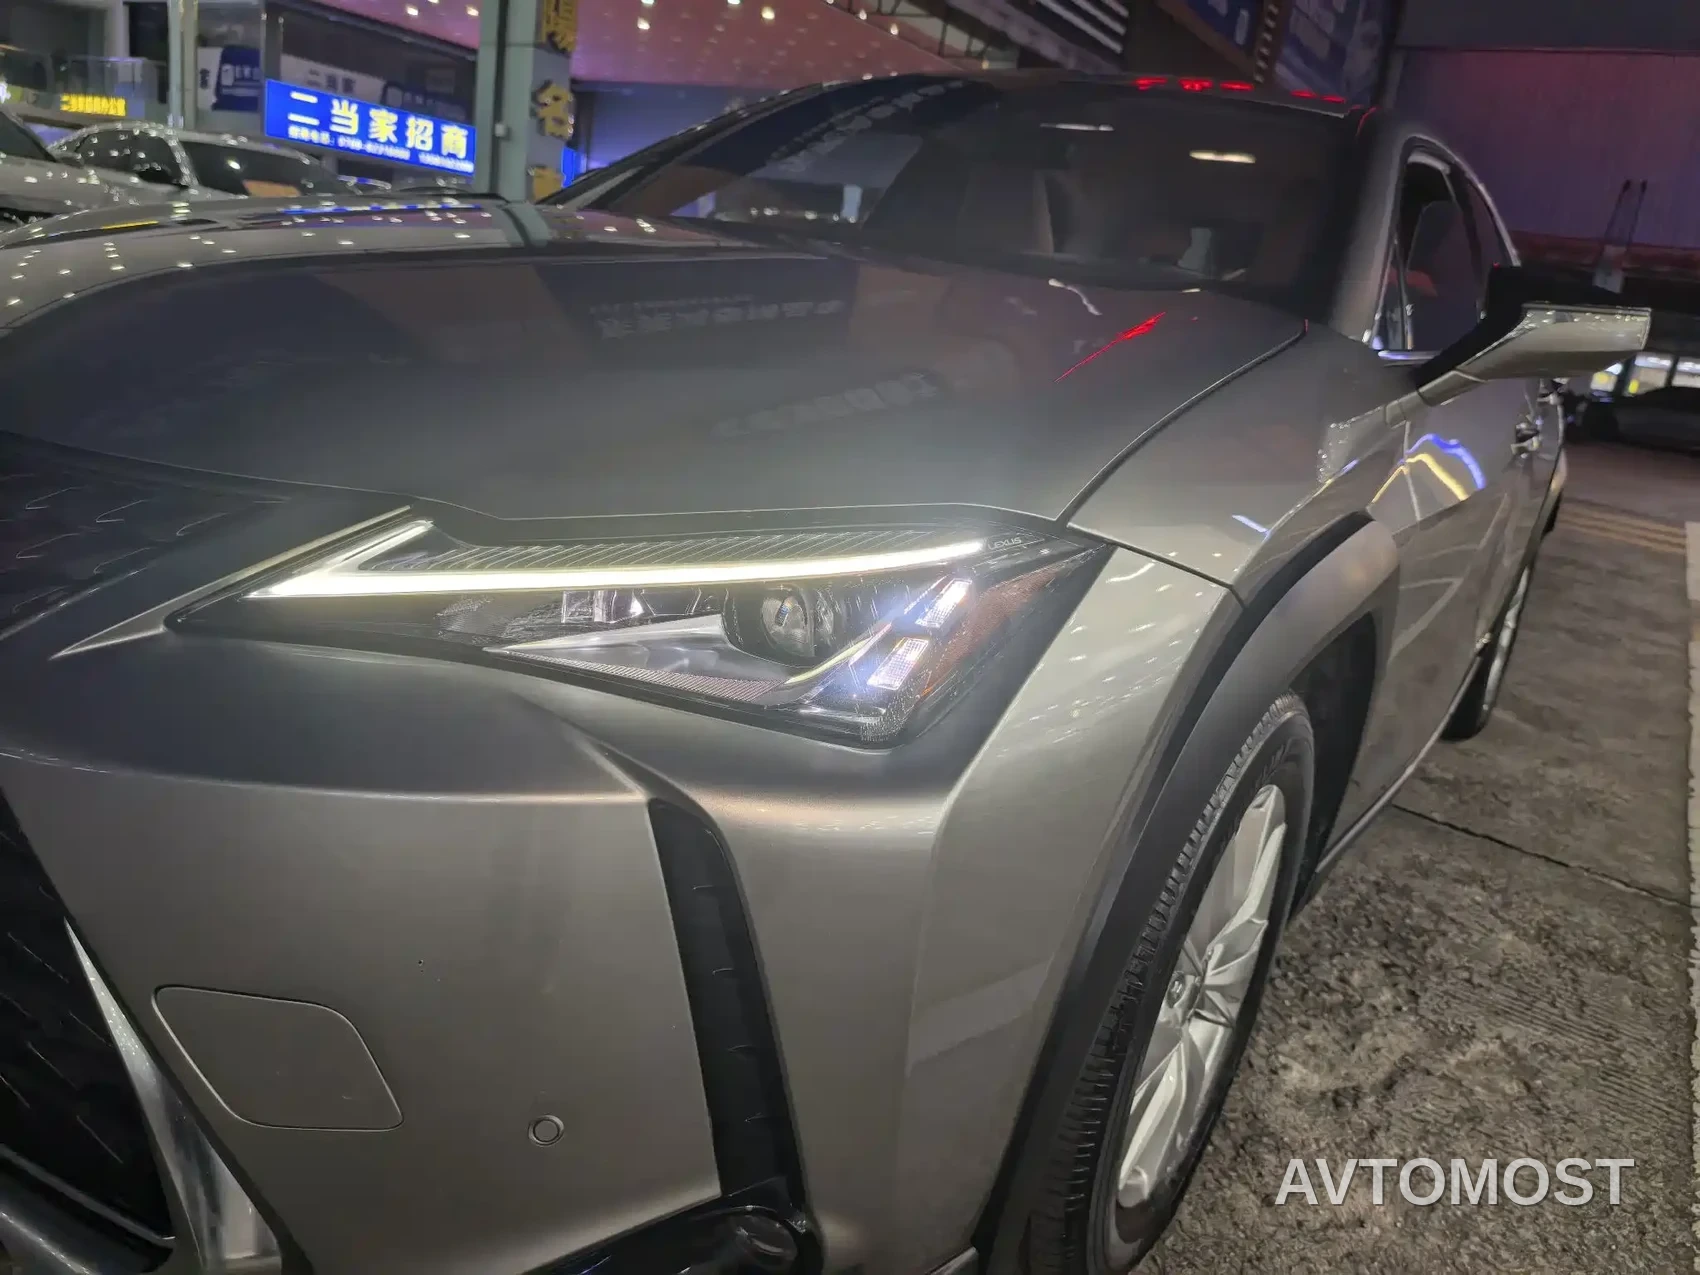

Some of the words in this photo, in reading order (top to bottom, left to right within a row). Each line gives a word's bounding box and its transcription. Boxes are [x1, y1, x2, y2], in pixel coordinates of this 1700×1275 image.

[287, 90, 469, 159] 二当家招商
[988, 537, 1022, 551] LEXUS
